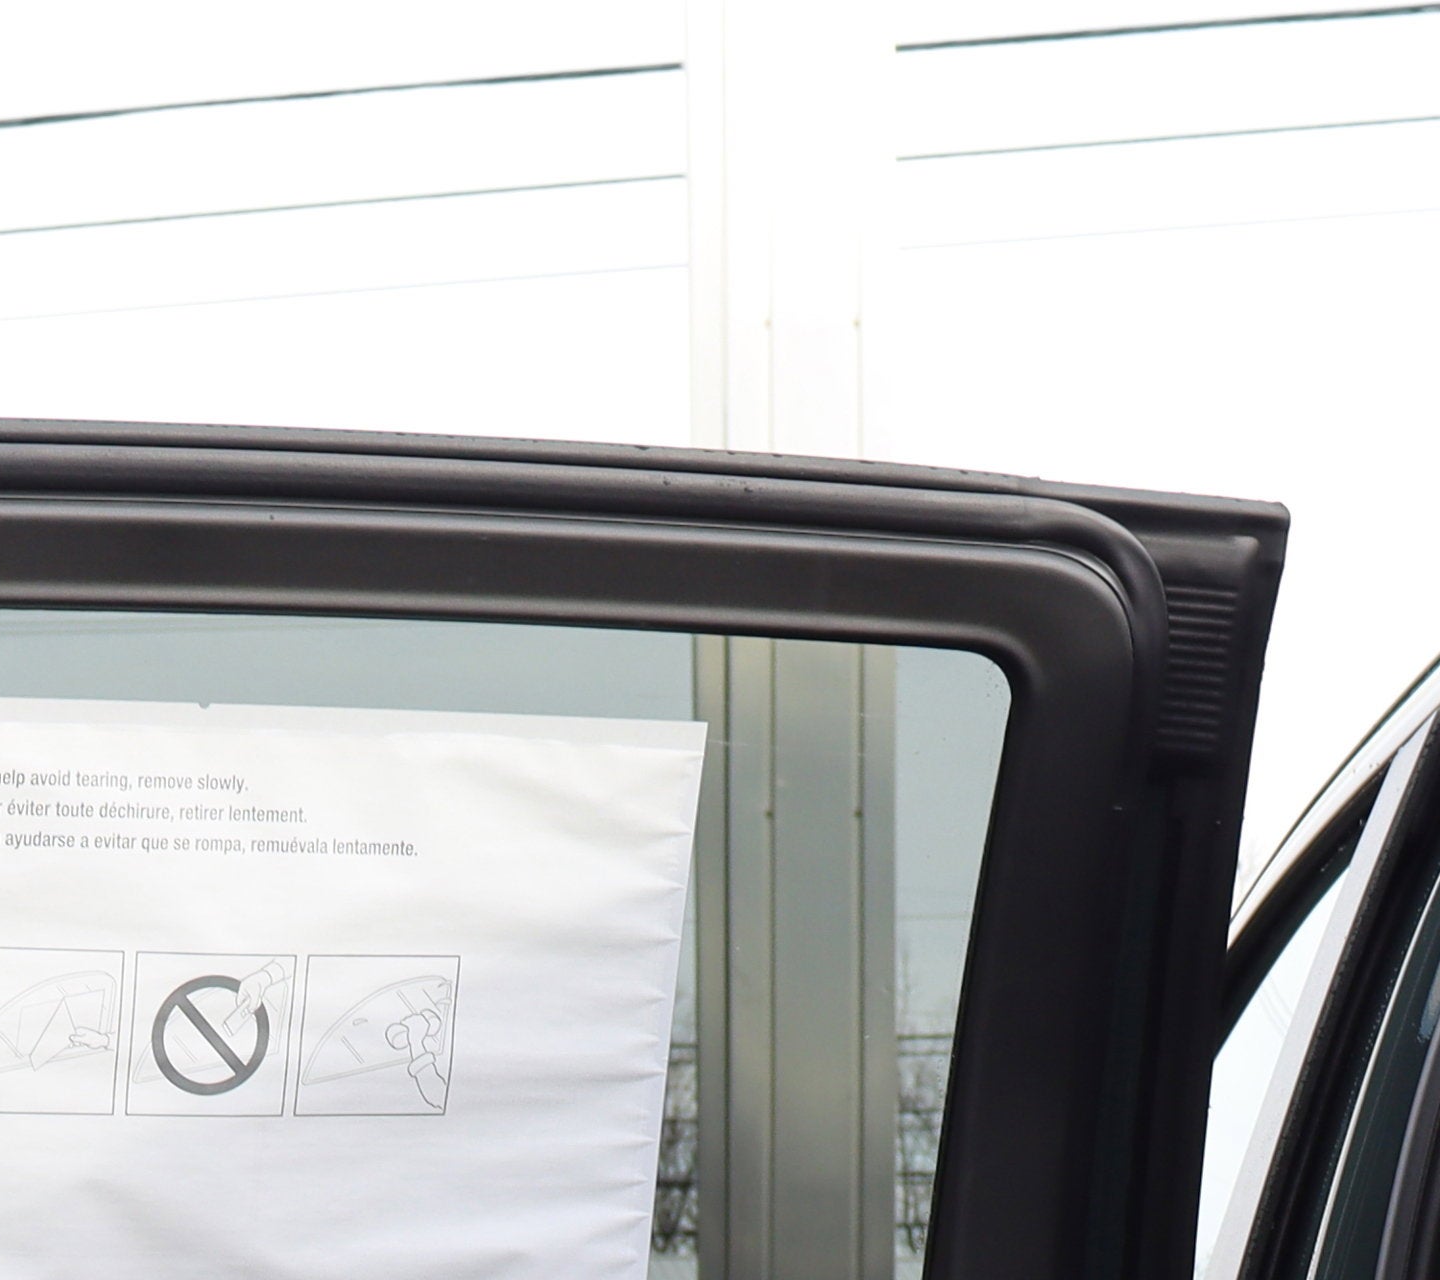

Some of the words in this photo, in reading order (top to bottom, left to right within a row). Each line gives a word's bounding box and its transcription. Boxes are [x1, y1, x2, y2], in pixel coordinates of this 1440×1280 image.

[30, 770, 71, 787] avoid
[76, 771, 133, 791] tearing,
[137, 775, 193, 790] remove
[196, 774, 249, 794] slowly.
[7, 799, 51, 817] éviter
[55, 802, 95, 818] toute
[99, 802, 175, 822] déchirure,
[179, 805, 224, 821] retirer
[228, 805, 308, 823] lentement.
[5, 831, 75, 850] ayudarse
[80, 835, 90, 849] a
[94, 832, 138, 850] evitar
[141, 836, 169, 853] que
[173, 837, 191, 851] se
[195, 838, 246, 855] rompa,
[250, 836, 328, 854] remuévala
[332, 839, 419, 857] lentamente.
